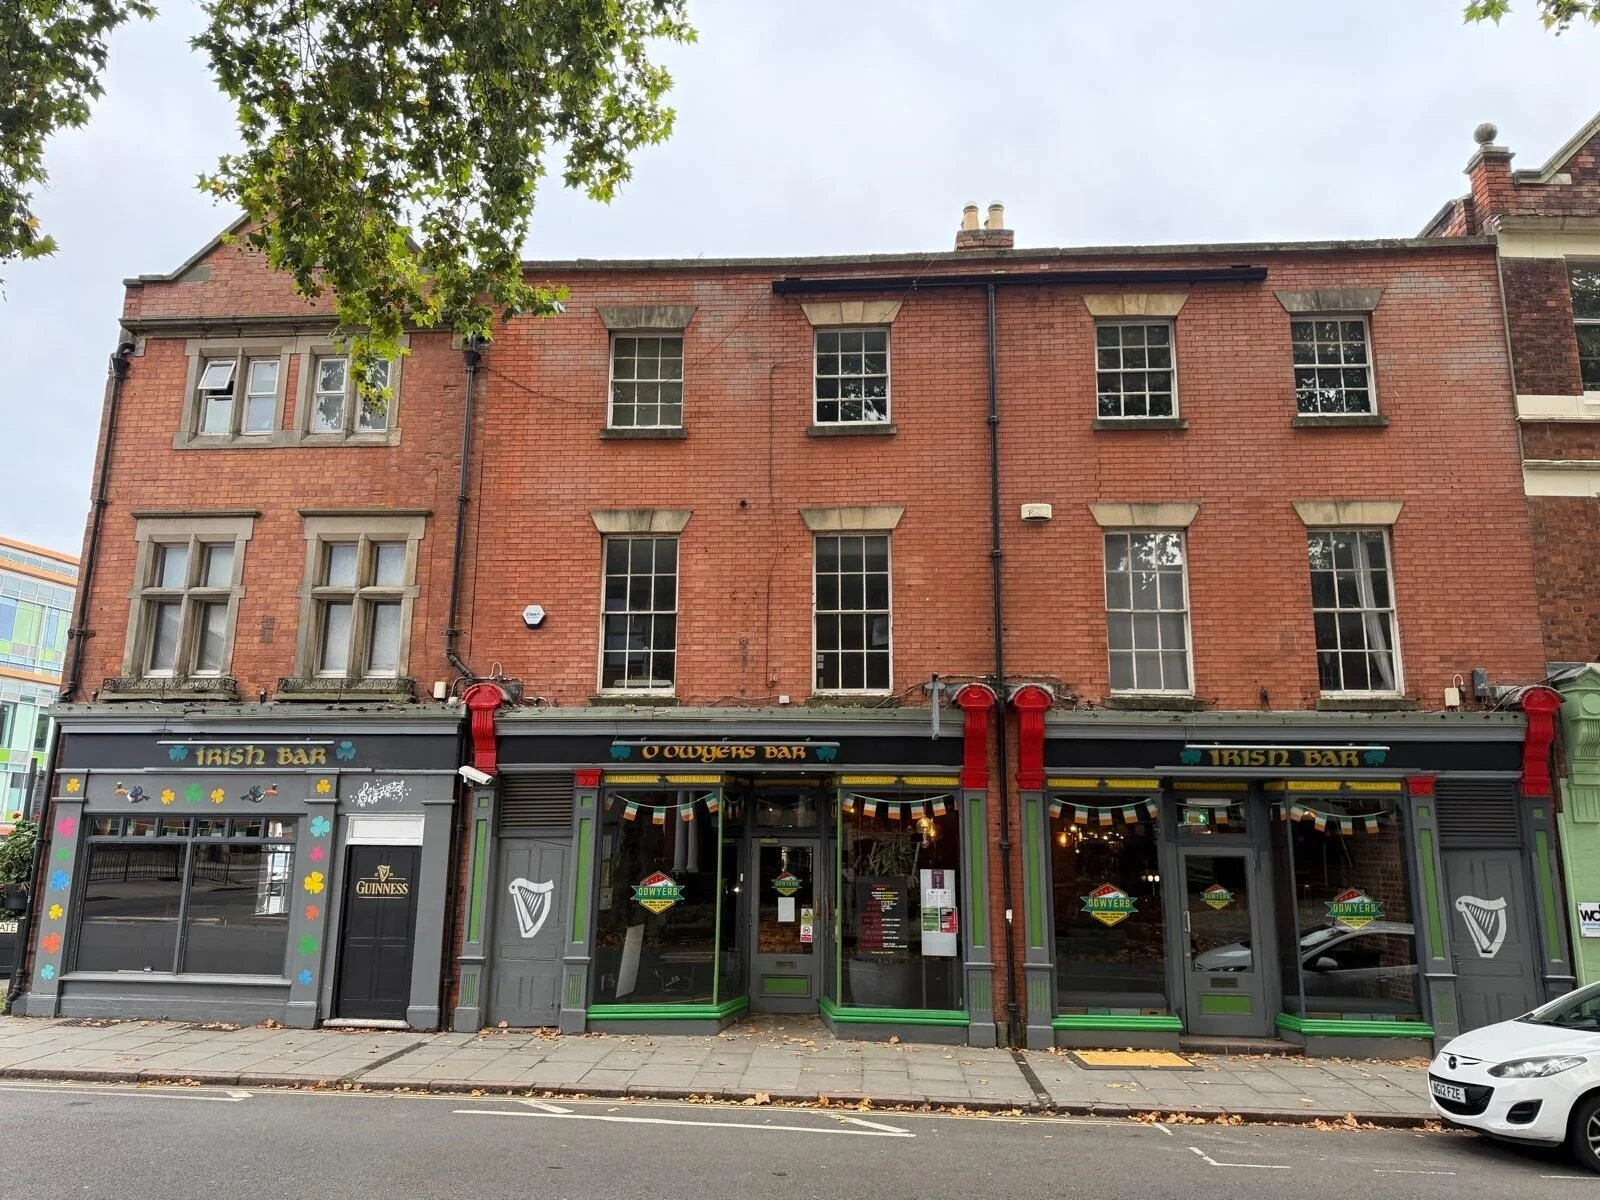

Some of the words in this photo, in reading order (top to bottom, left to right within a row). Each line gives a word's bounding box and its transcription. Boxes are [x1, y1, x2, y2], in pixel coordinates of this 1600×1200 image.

[277, 746, 327, 765] BAR
[764, 745, 806, 760] BAR
[1303, 750, 1359, 767] BAR
[356, 881, 409, 895] GUINNESS
[1446, 1086, 1461, 1100] FZE
